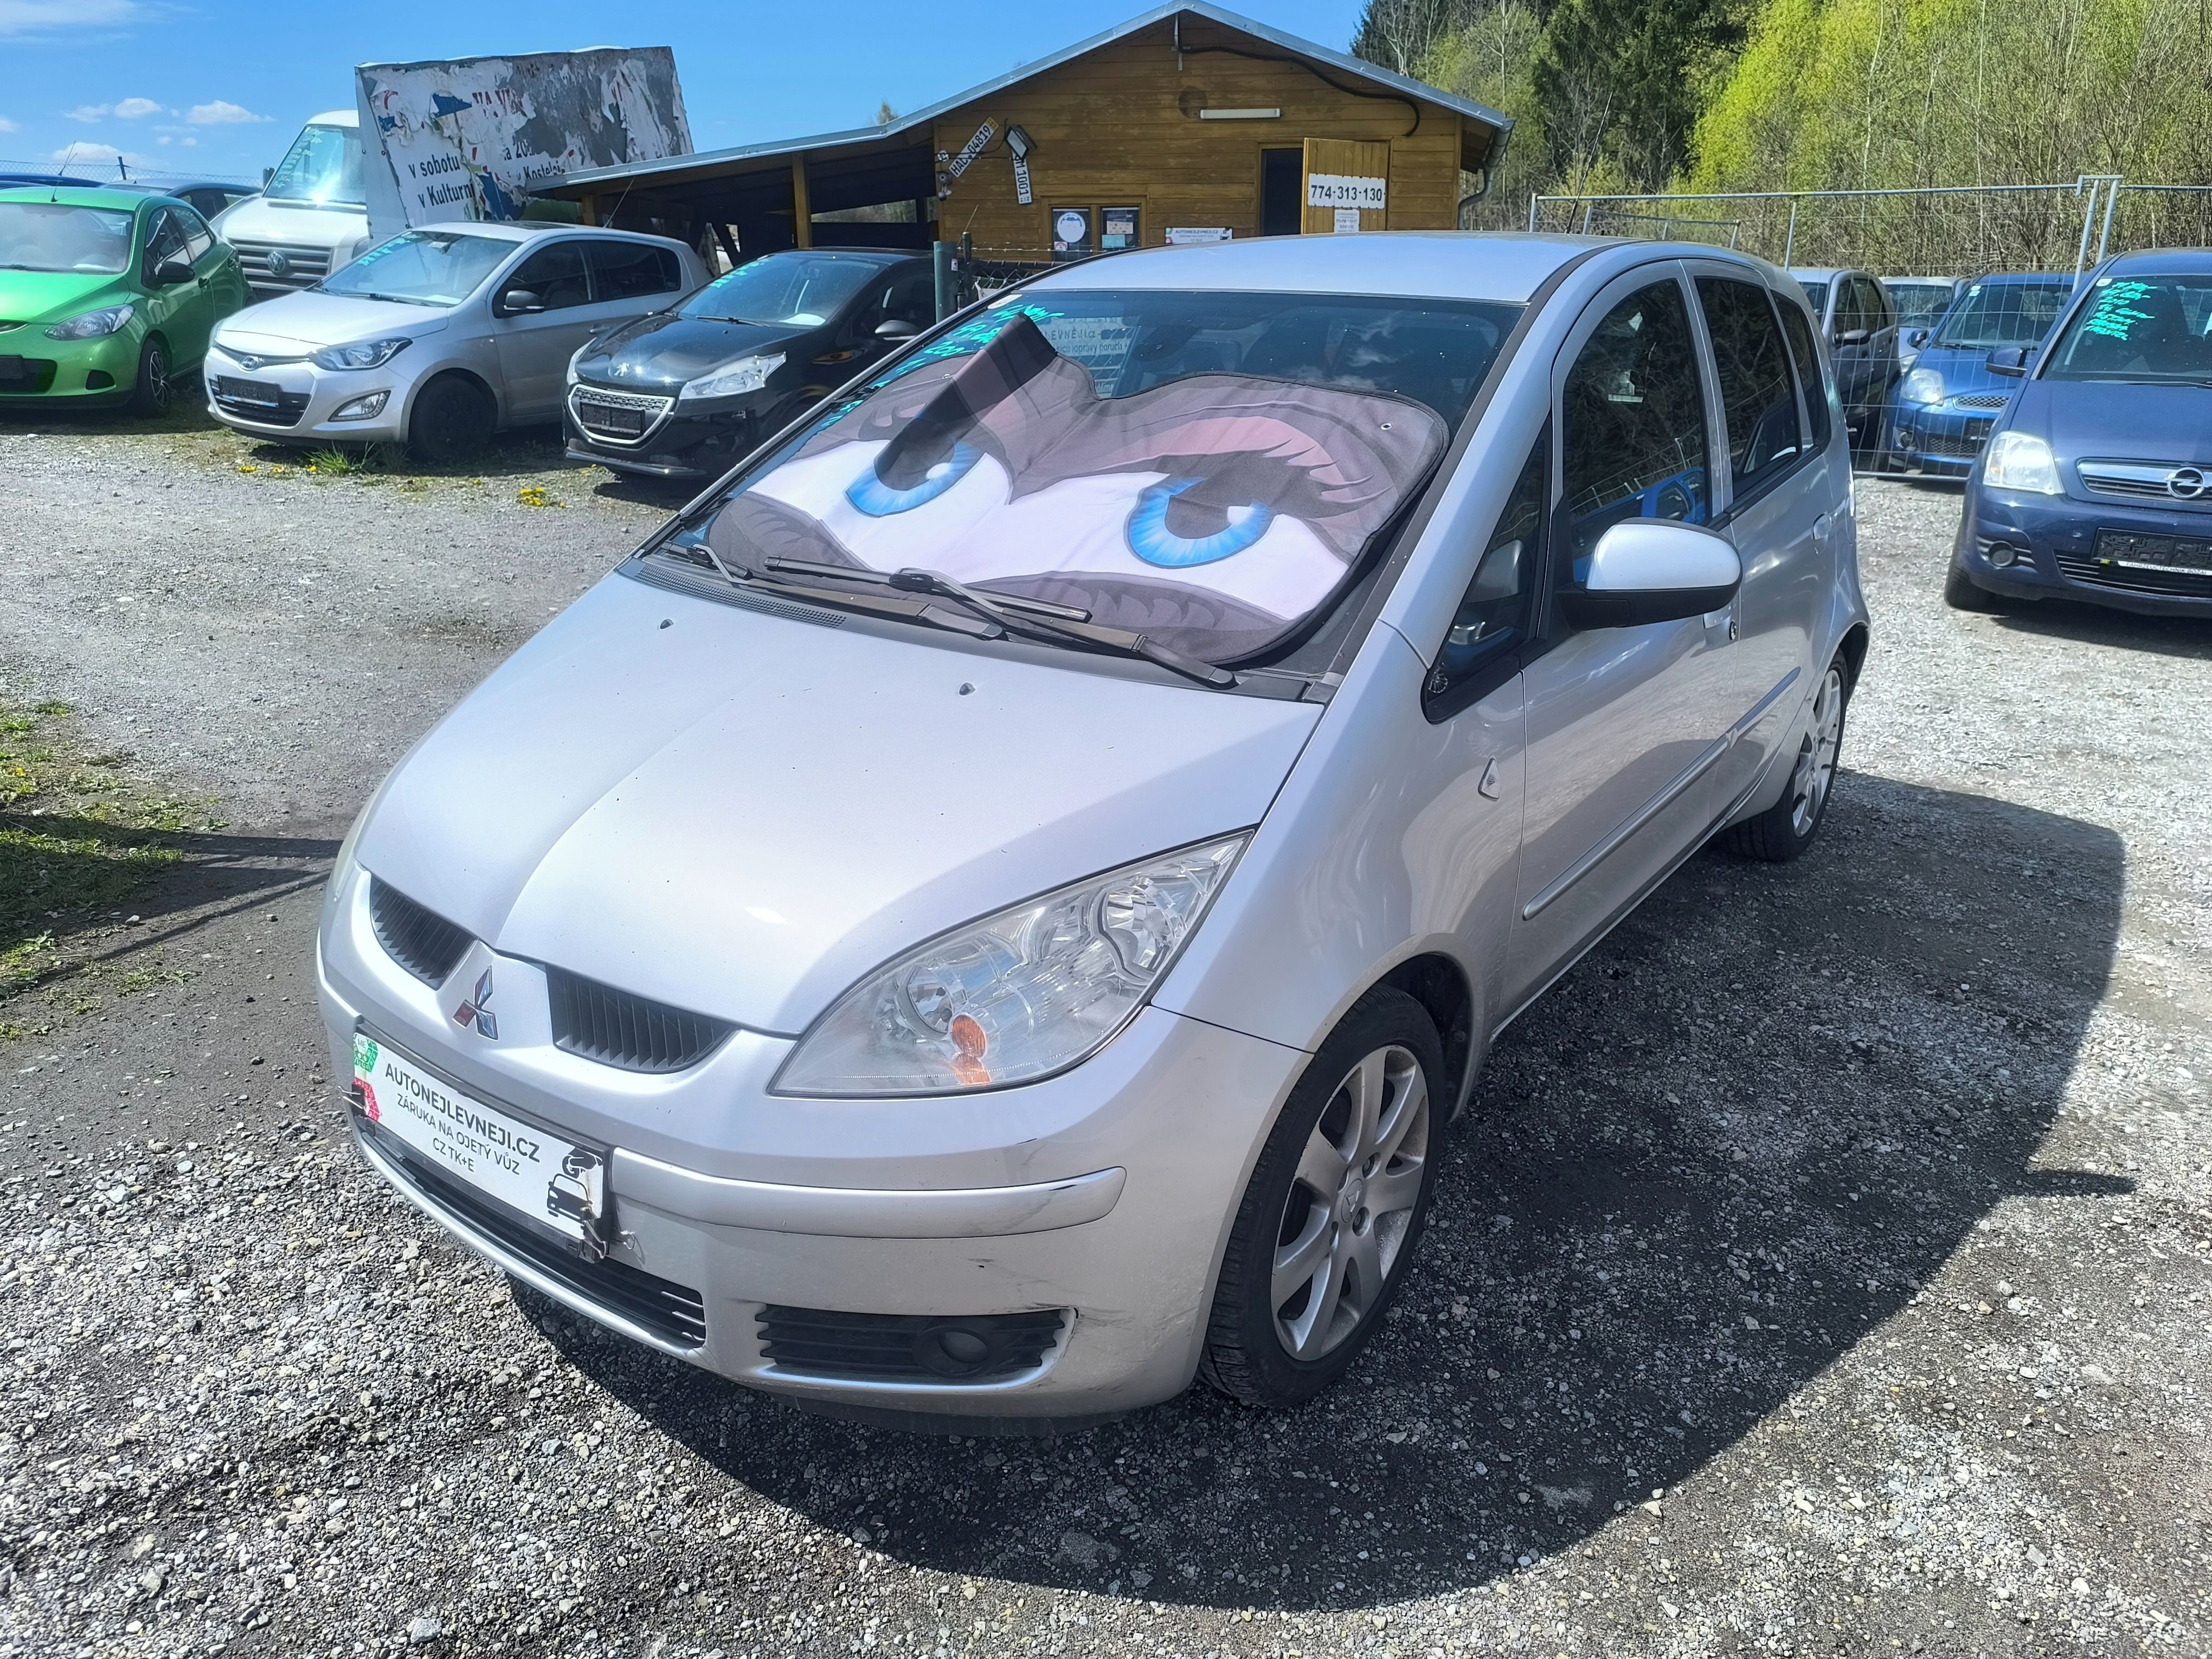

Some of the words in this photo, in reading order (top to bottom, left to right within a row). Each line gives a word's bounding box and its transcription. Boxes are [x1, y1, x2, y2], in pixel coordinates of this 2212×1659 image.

[967, 125, 991, 156] 04819
[408, 164, 416, 179] v
[420, 152, 461, 177] sobotu
[1017, 171, 1029, 196] 1001
[1311, 184, 1382, 202] 774-313-130
[417, 194, 426, 209] v
[385, 1063, 540, 1163] AUTONEJLEVNEJI.CZ
[397, 1093, 436, 1129] ZÁRUKA
[439, 1120, 454, 1140] NA
[456, 1131, 492, 1160] OJETÝ
[494, 1152, 520, 1175] VŮZ
[433, 1137, 446, 1156] CZ
[448, 1146, 474, 1173] TK+E
